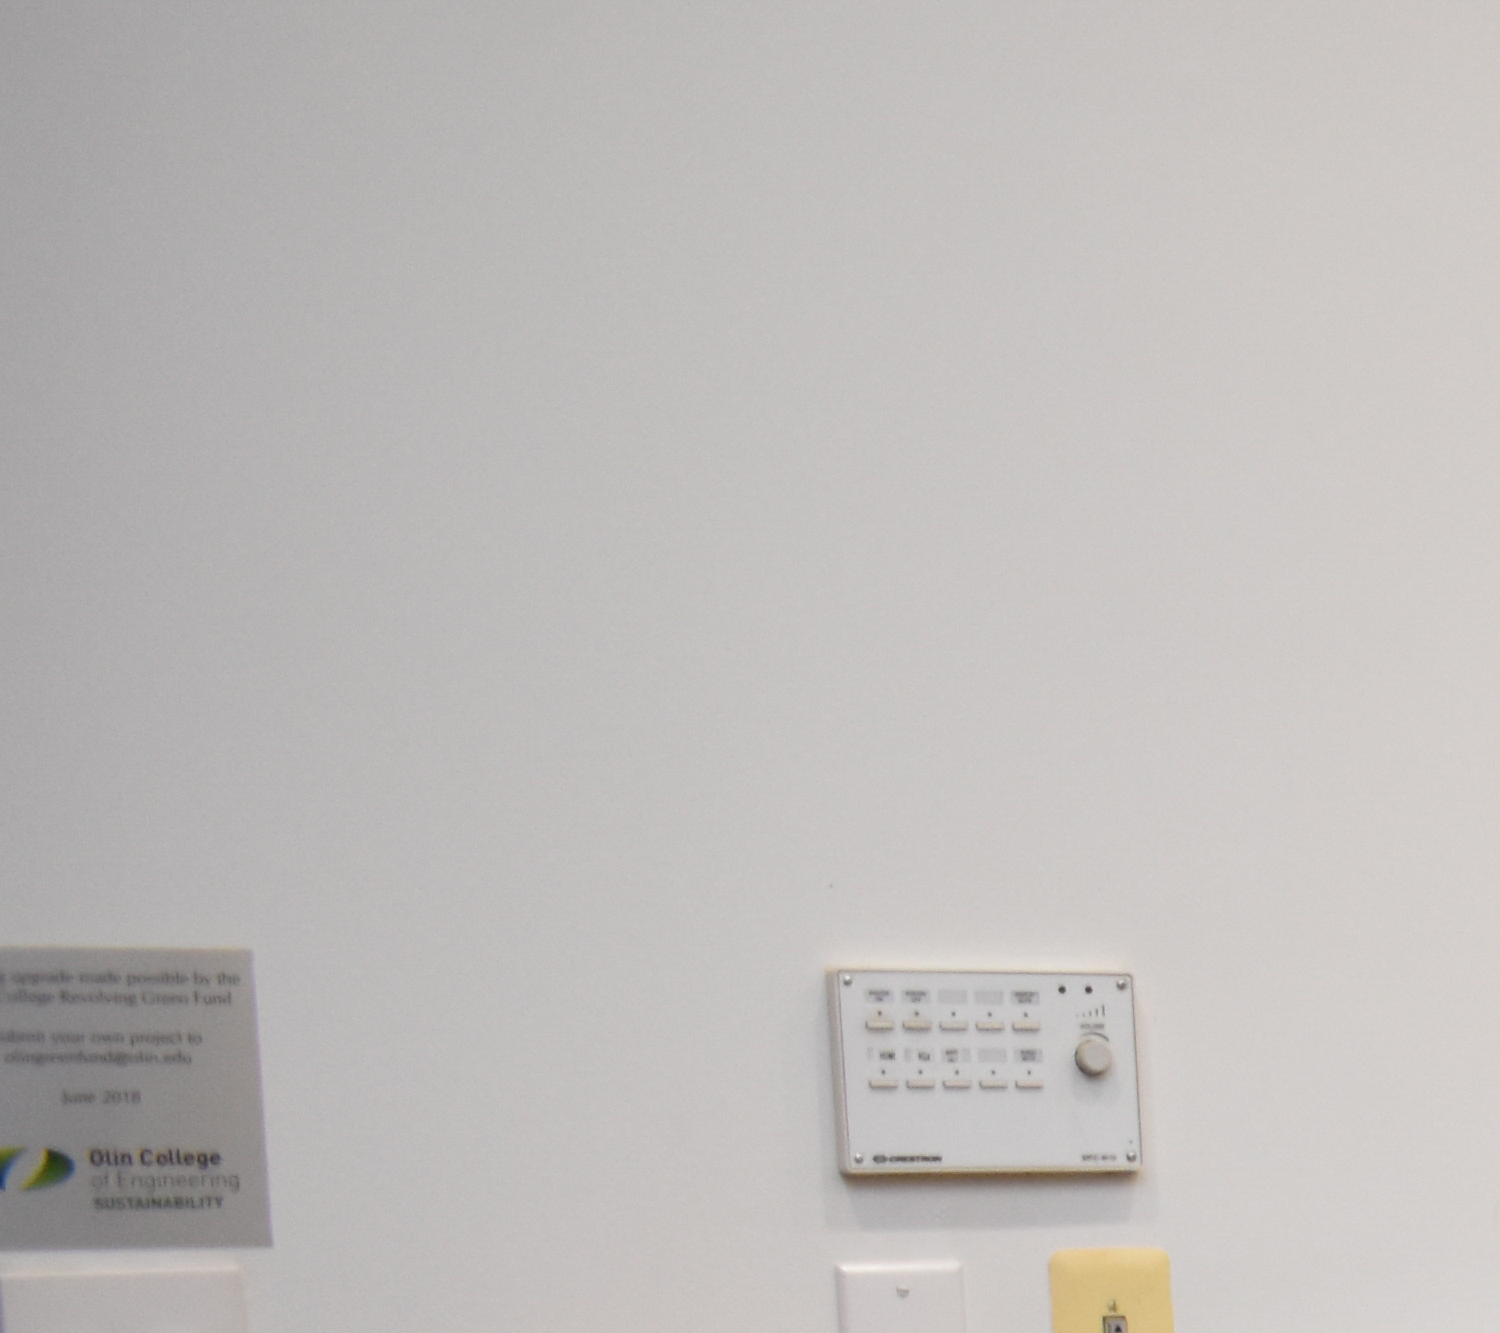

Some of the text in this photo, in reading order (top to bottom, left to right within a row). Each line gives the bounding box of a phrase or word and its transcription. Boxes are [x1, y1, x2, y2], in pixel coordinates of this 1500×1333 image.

[79, 970, 121, 985] made
[127, 970, 189, 987] possible
[193, 970, 211, 987] by
[216, 970, 241, 986] the
[59, 989, 137, 1007] Revolving
[141, 990, 189, 1006] Green
[193, 990, 233, 1006] Fund
[0, 1029, 203, 1047] ubmit your own project to
[61, 1089, 142, 1106] June 2018
[88, 1148, 223, 1169] Olin College
[90, 1171, 241, 1192] of Engineering
[93, 1195, 225, 1211] SUSTAINABILITY
